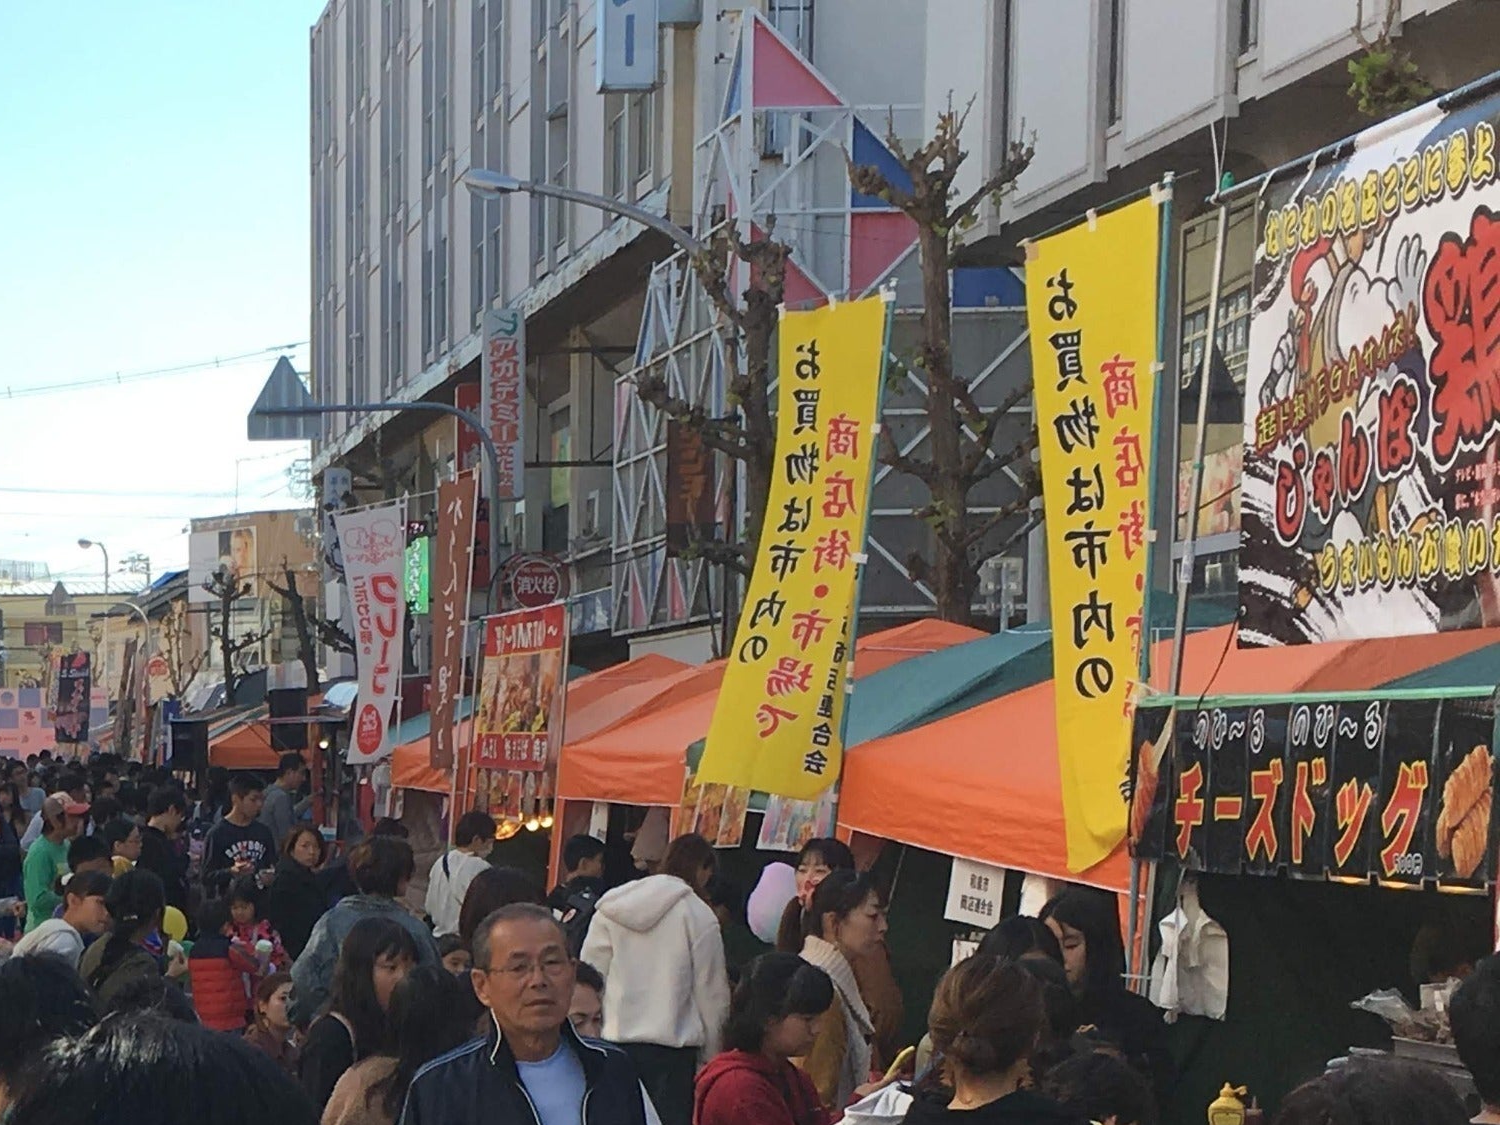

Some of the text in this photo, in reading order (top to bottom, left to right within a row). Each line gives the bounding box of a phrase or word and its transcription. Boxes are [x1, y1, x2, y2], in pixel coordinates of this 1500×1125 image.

[516, 575, 557, 596] 消火栓
[1173, 756, 1430, 878] チーズドッグ
